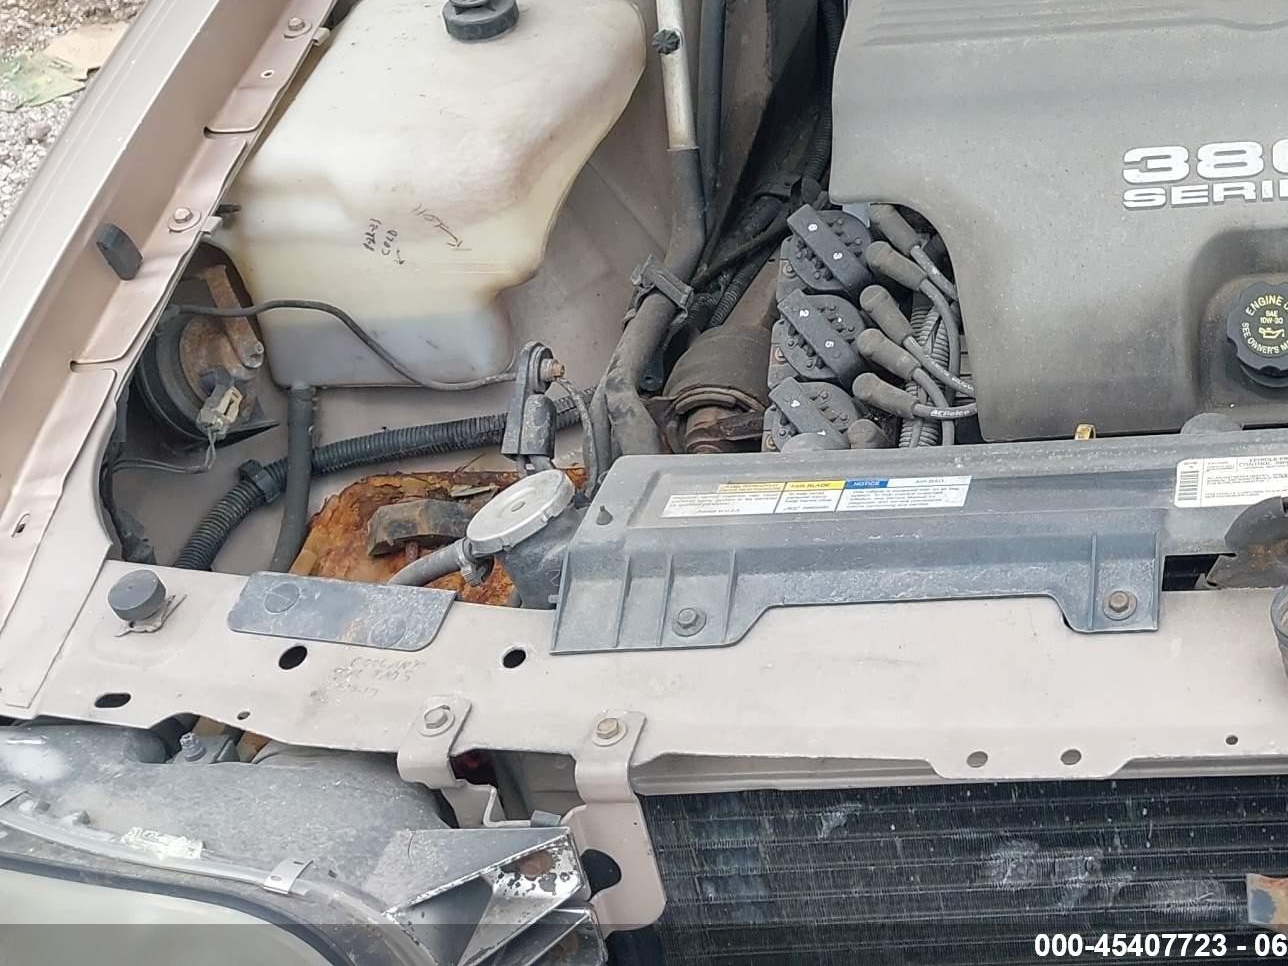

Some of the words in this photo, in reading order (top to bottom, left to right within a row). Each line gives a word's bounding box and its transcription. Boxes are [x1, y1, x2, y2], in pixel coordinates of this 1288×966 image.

[1245, 295, 1284, 316] ENGINE
[1265, 310, 1278, 318] SAE
[1241, 322, 1252, 338] SEE
[1247, 337, 1280, 354] OWNER'S
